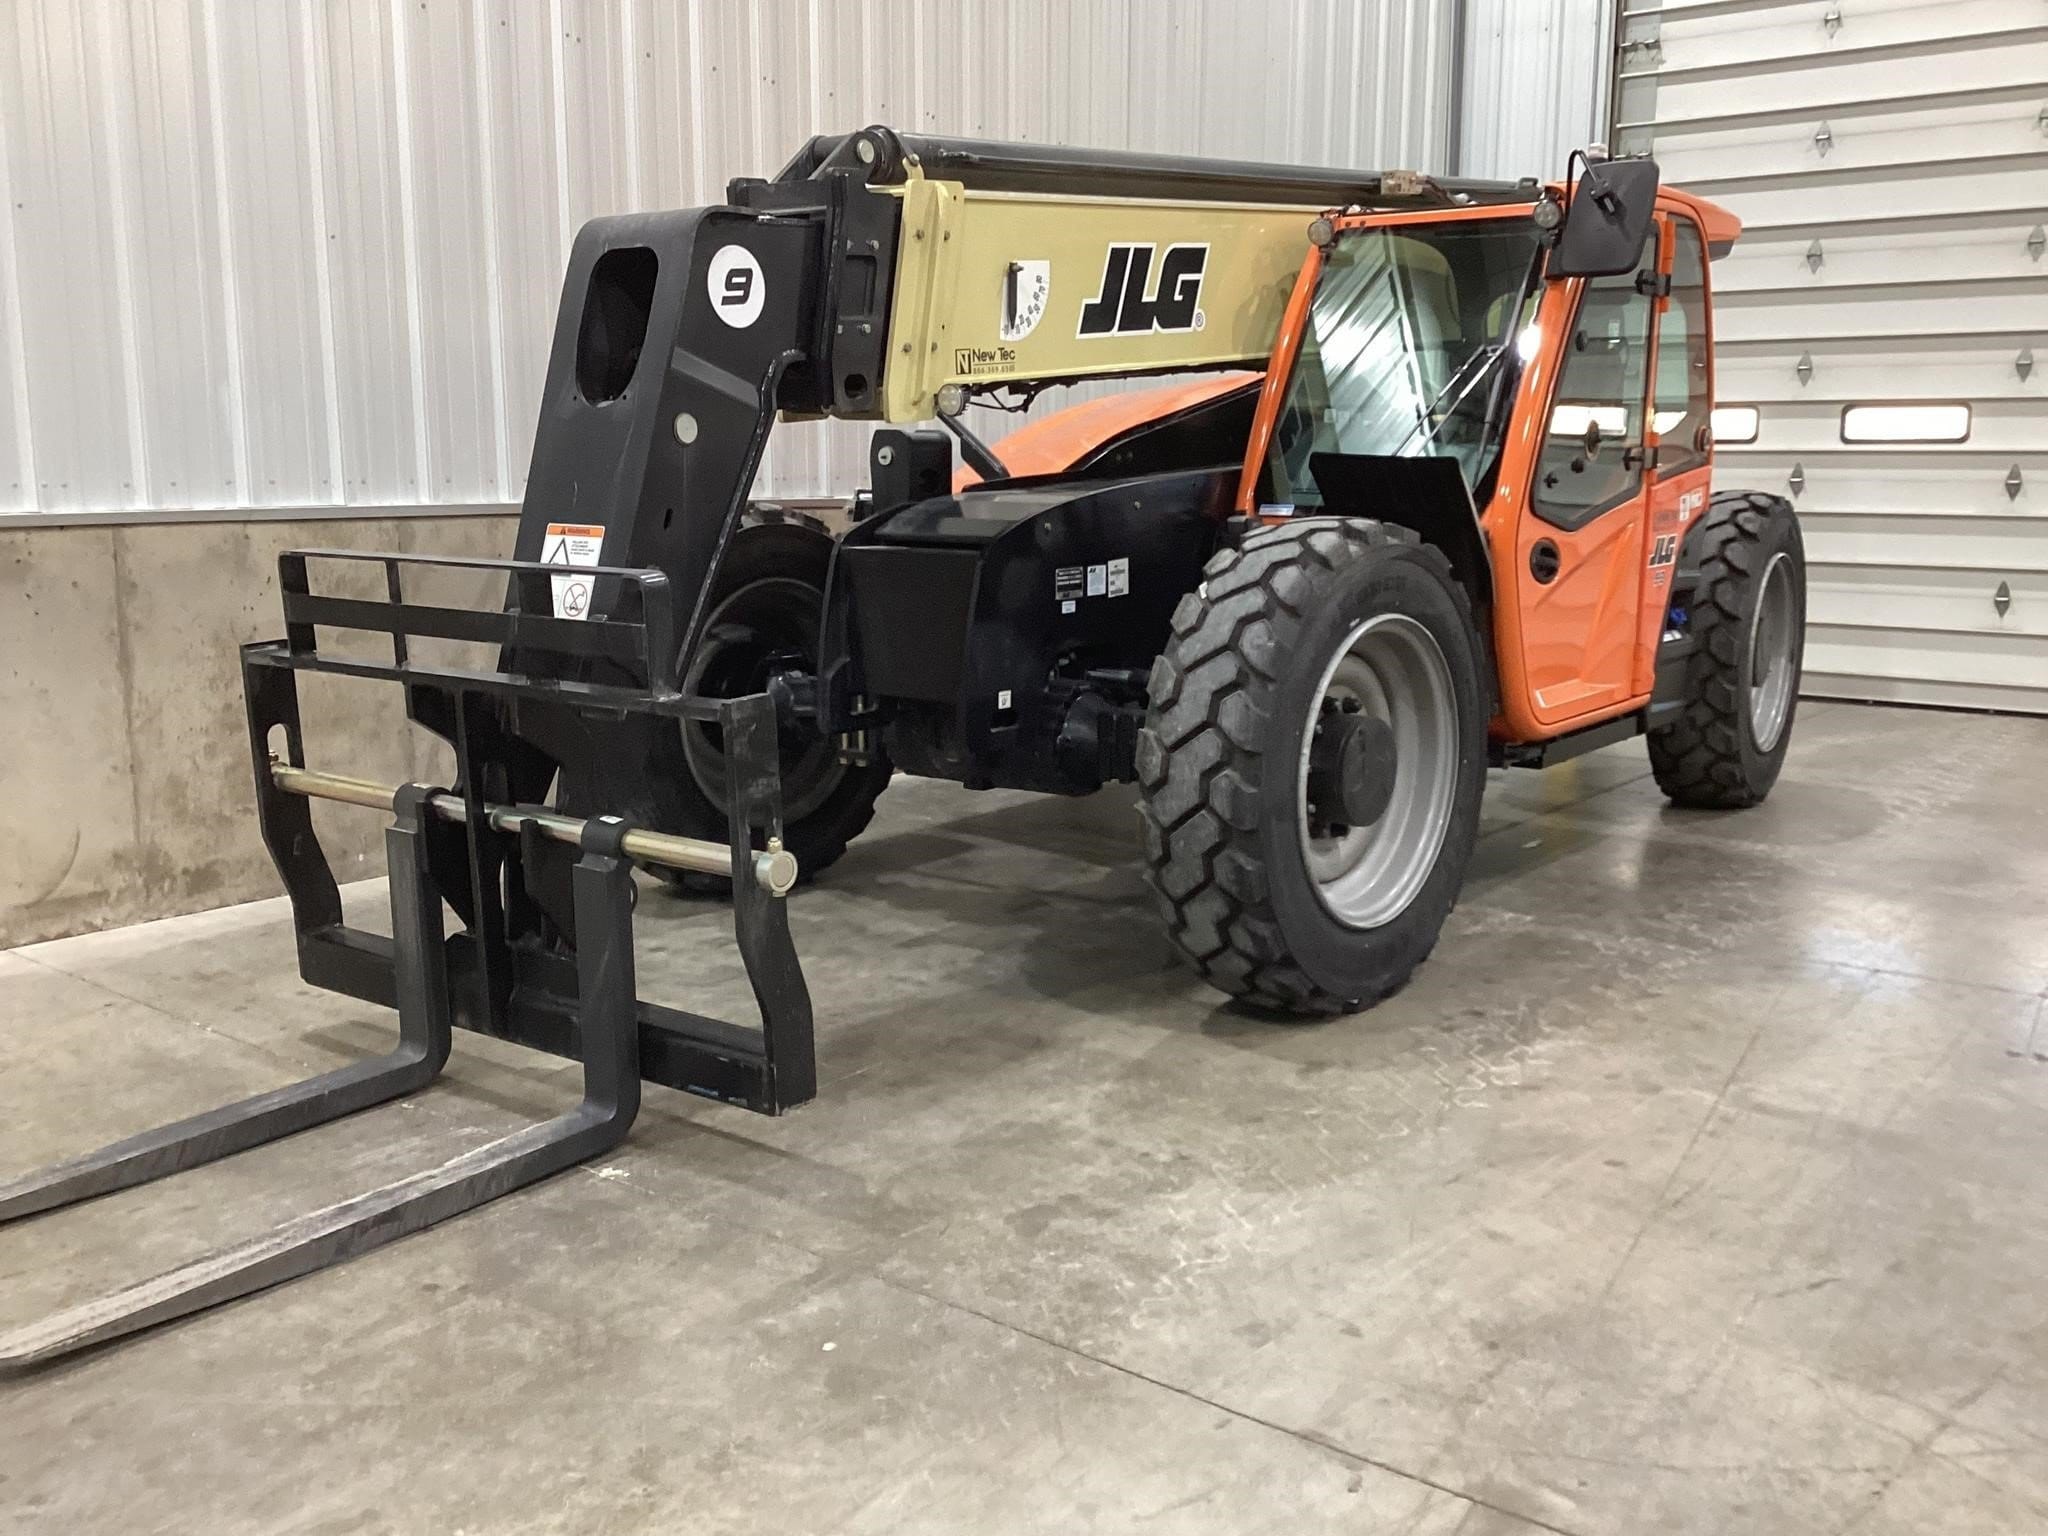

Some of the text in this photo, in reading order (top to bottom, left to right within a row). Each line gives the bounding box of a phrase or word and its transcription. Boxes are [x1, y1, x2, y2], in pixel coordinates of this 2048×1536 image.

[721, 268, 753, 306] 9
[1077, 244, 1209, 337] JLG
[972, 348, 996, 362] New
[997, 347, 1016, 361] Tec
[1648, 534, 1677, 568] JLG
